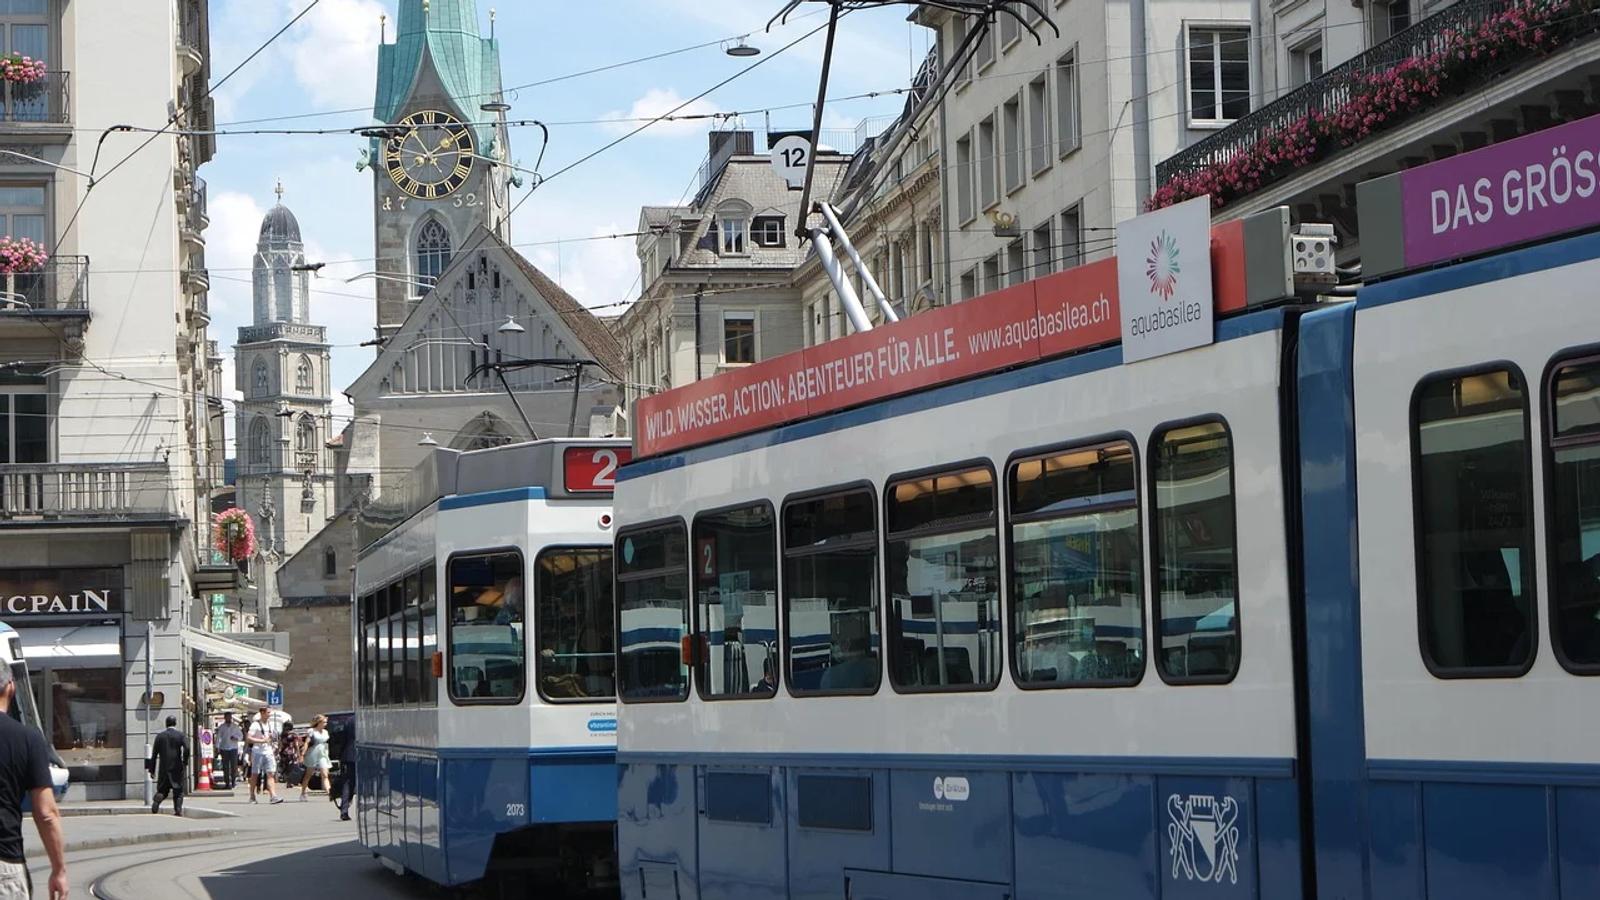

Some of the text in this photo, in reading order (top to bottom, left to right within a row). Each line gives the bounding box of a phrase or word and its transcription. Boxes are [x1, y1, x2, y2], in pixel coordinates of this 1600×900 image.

[780, 147, 806, 168] 12
[1431, 144, 1600, 235] DAS GRÖS
[1131, 300, 1201, 338] aquabasilea
[645, 293, 1111, 441] WILD. WASSER. ACTION: ABENTEUER FÜR ALLE. www.aquabasilea.ch
[592, 449, 617, 486] 2
[704, 544, 713, 574] 2
[0, 590, 110, 614] CPAIN
[506, 803, 524, 816] 2073
